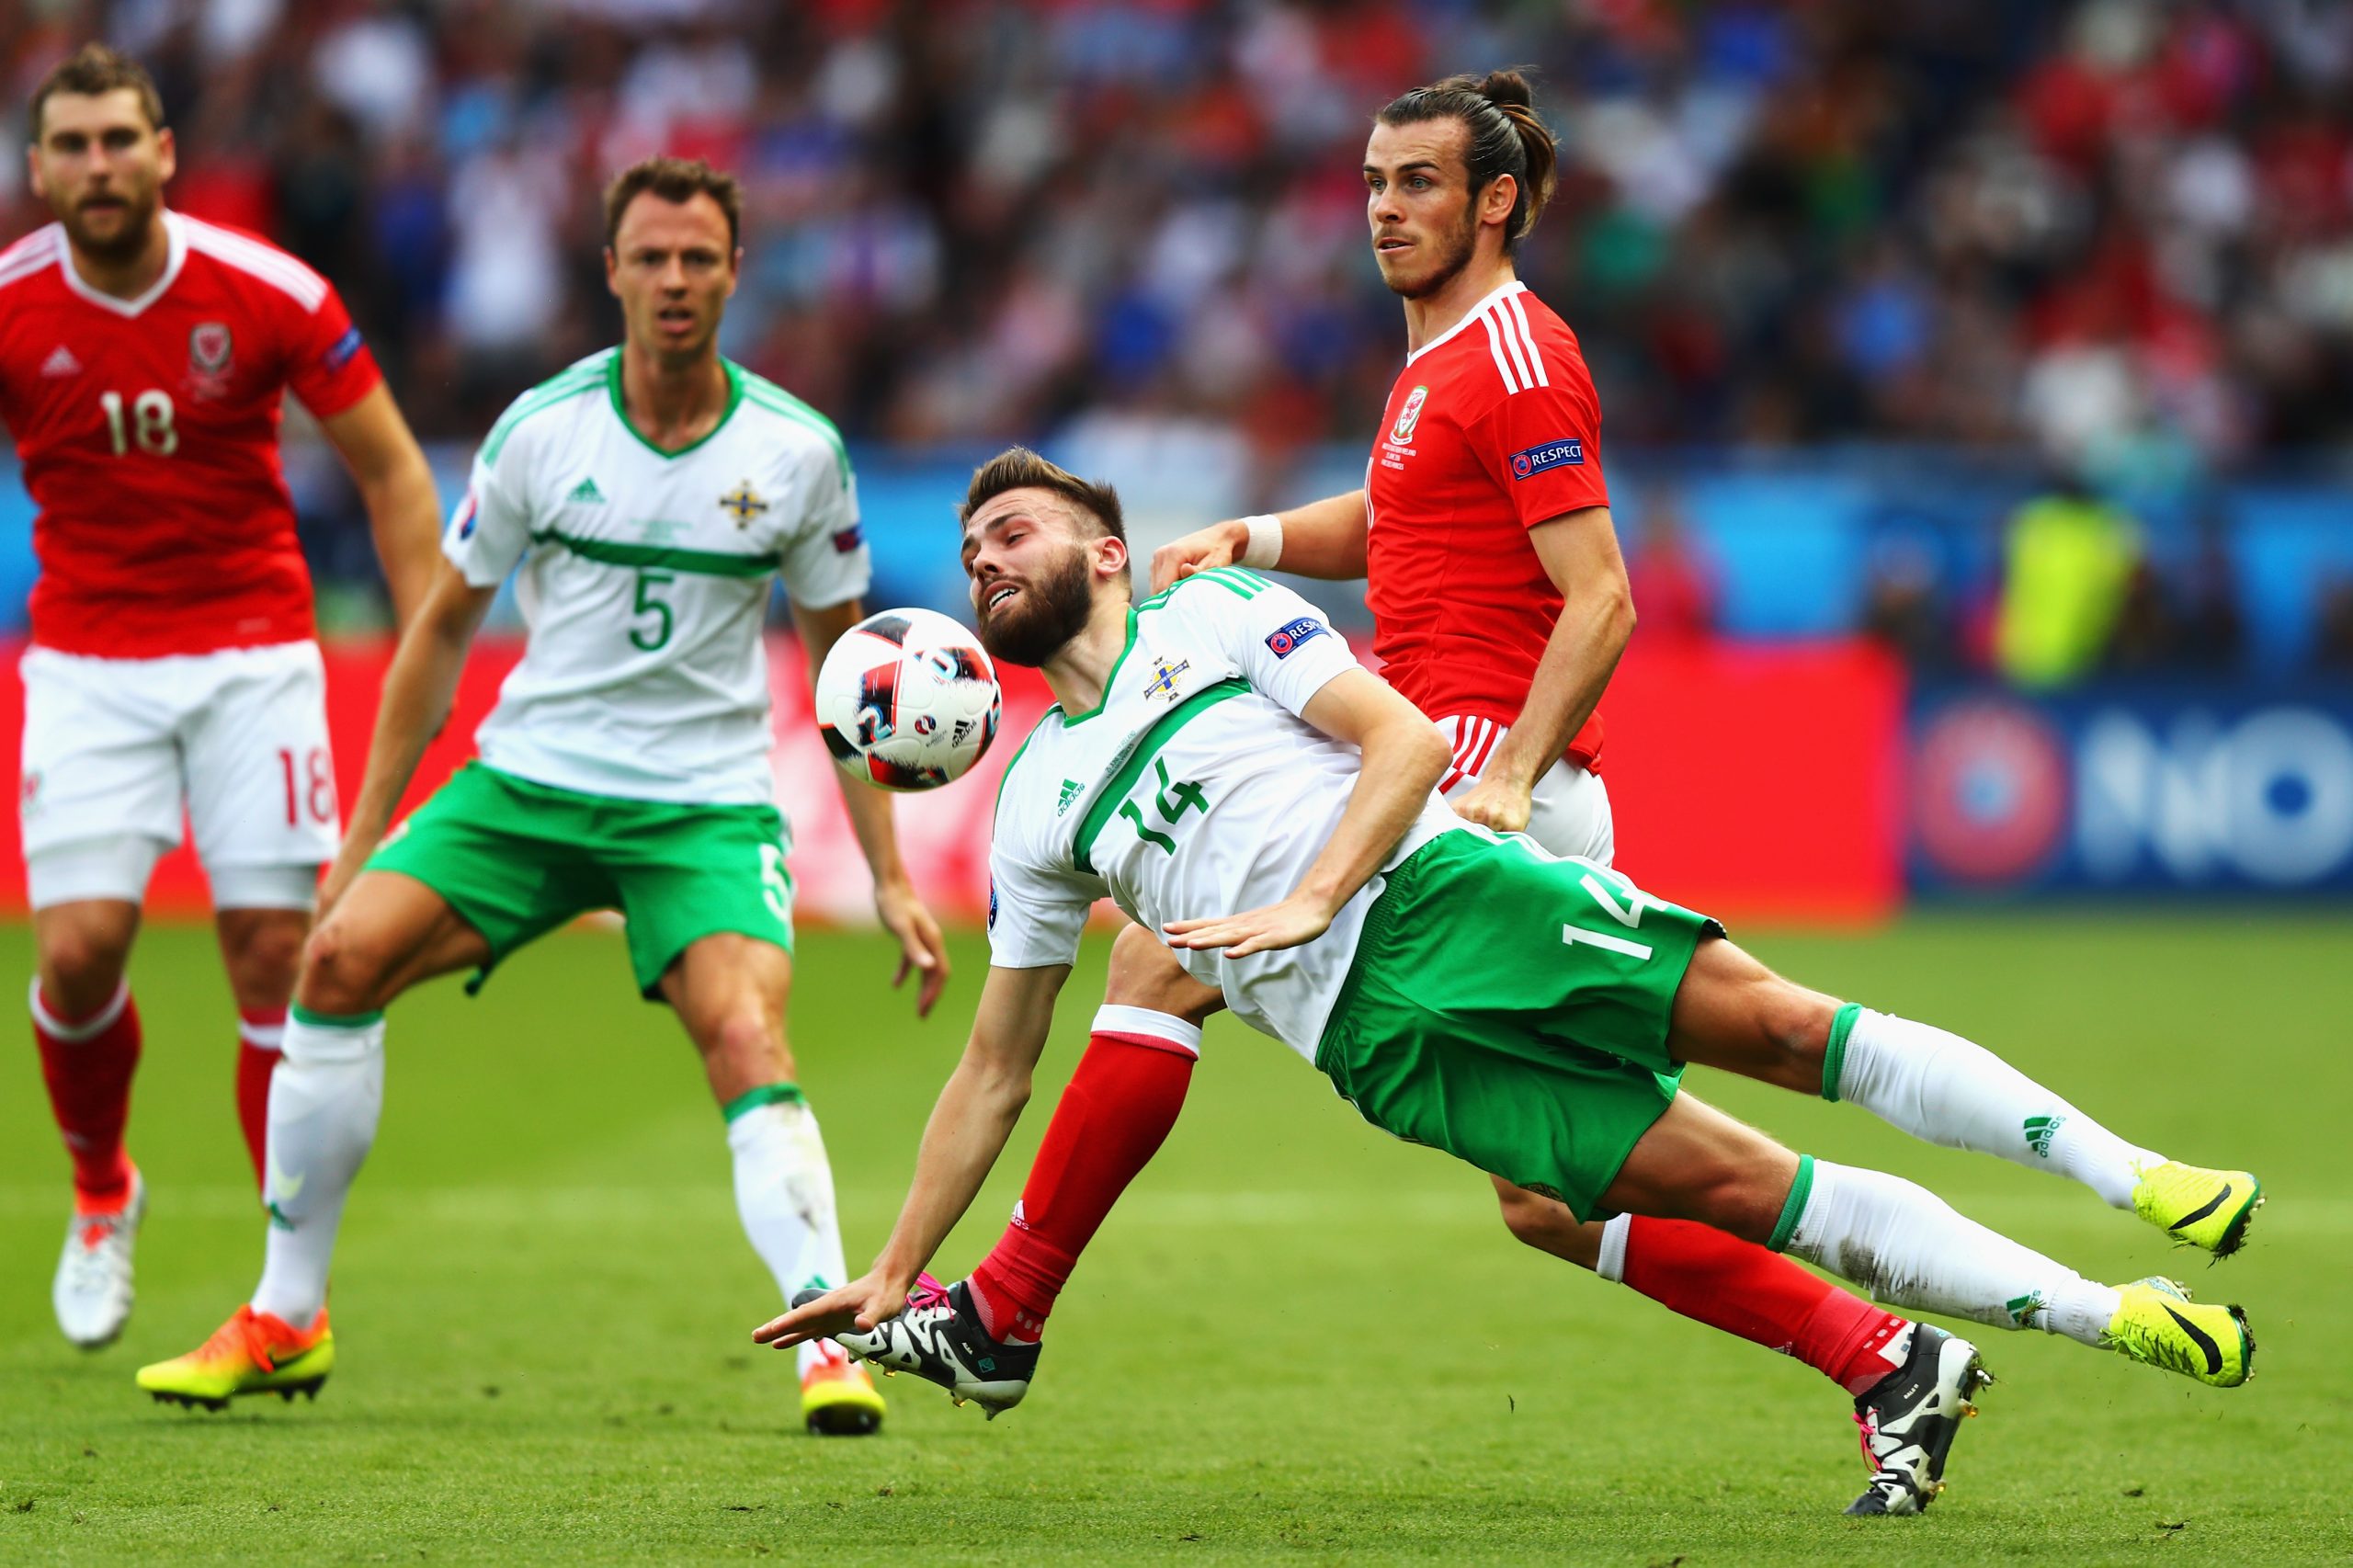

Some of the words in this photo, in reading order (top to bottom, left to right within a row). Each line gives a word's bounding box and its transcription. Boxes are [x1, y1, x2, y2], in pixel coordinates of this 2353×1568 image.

[99, 388, 178, 457] 18
[1531, 446, 1581, 466] RESPECT
[629, 573, 674, 652] 5
[952, 720, 978, 749] adidas
[278, 745, 336, 828] 18
[1057, 783, 1086, 817] adidas
[1118, 756, 1210, 856] 14
[758, 843, 793, 923] 5
[1562, 872, 1670, 961] 14
[2040, 1115, 2067, 1158] adidas
